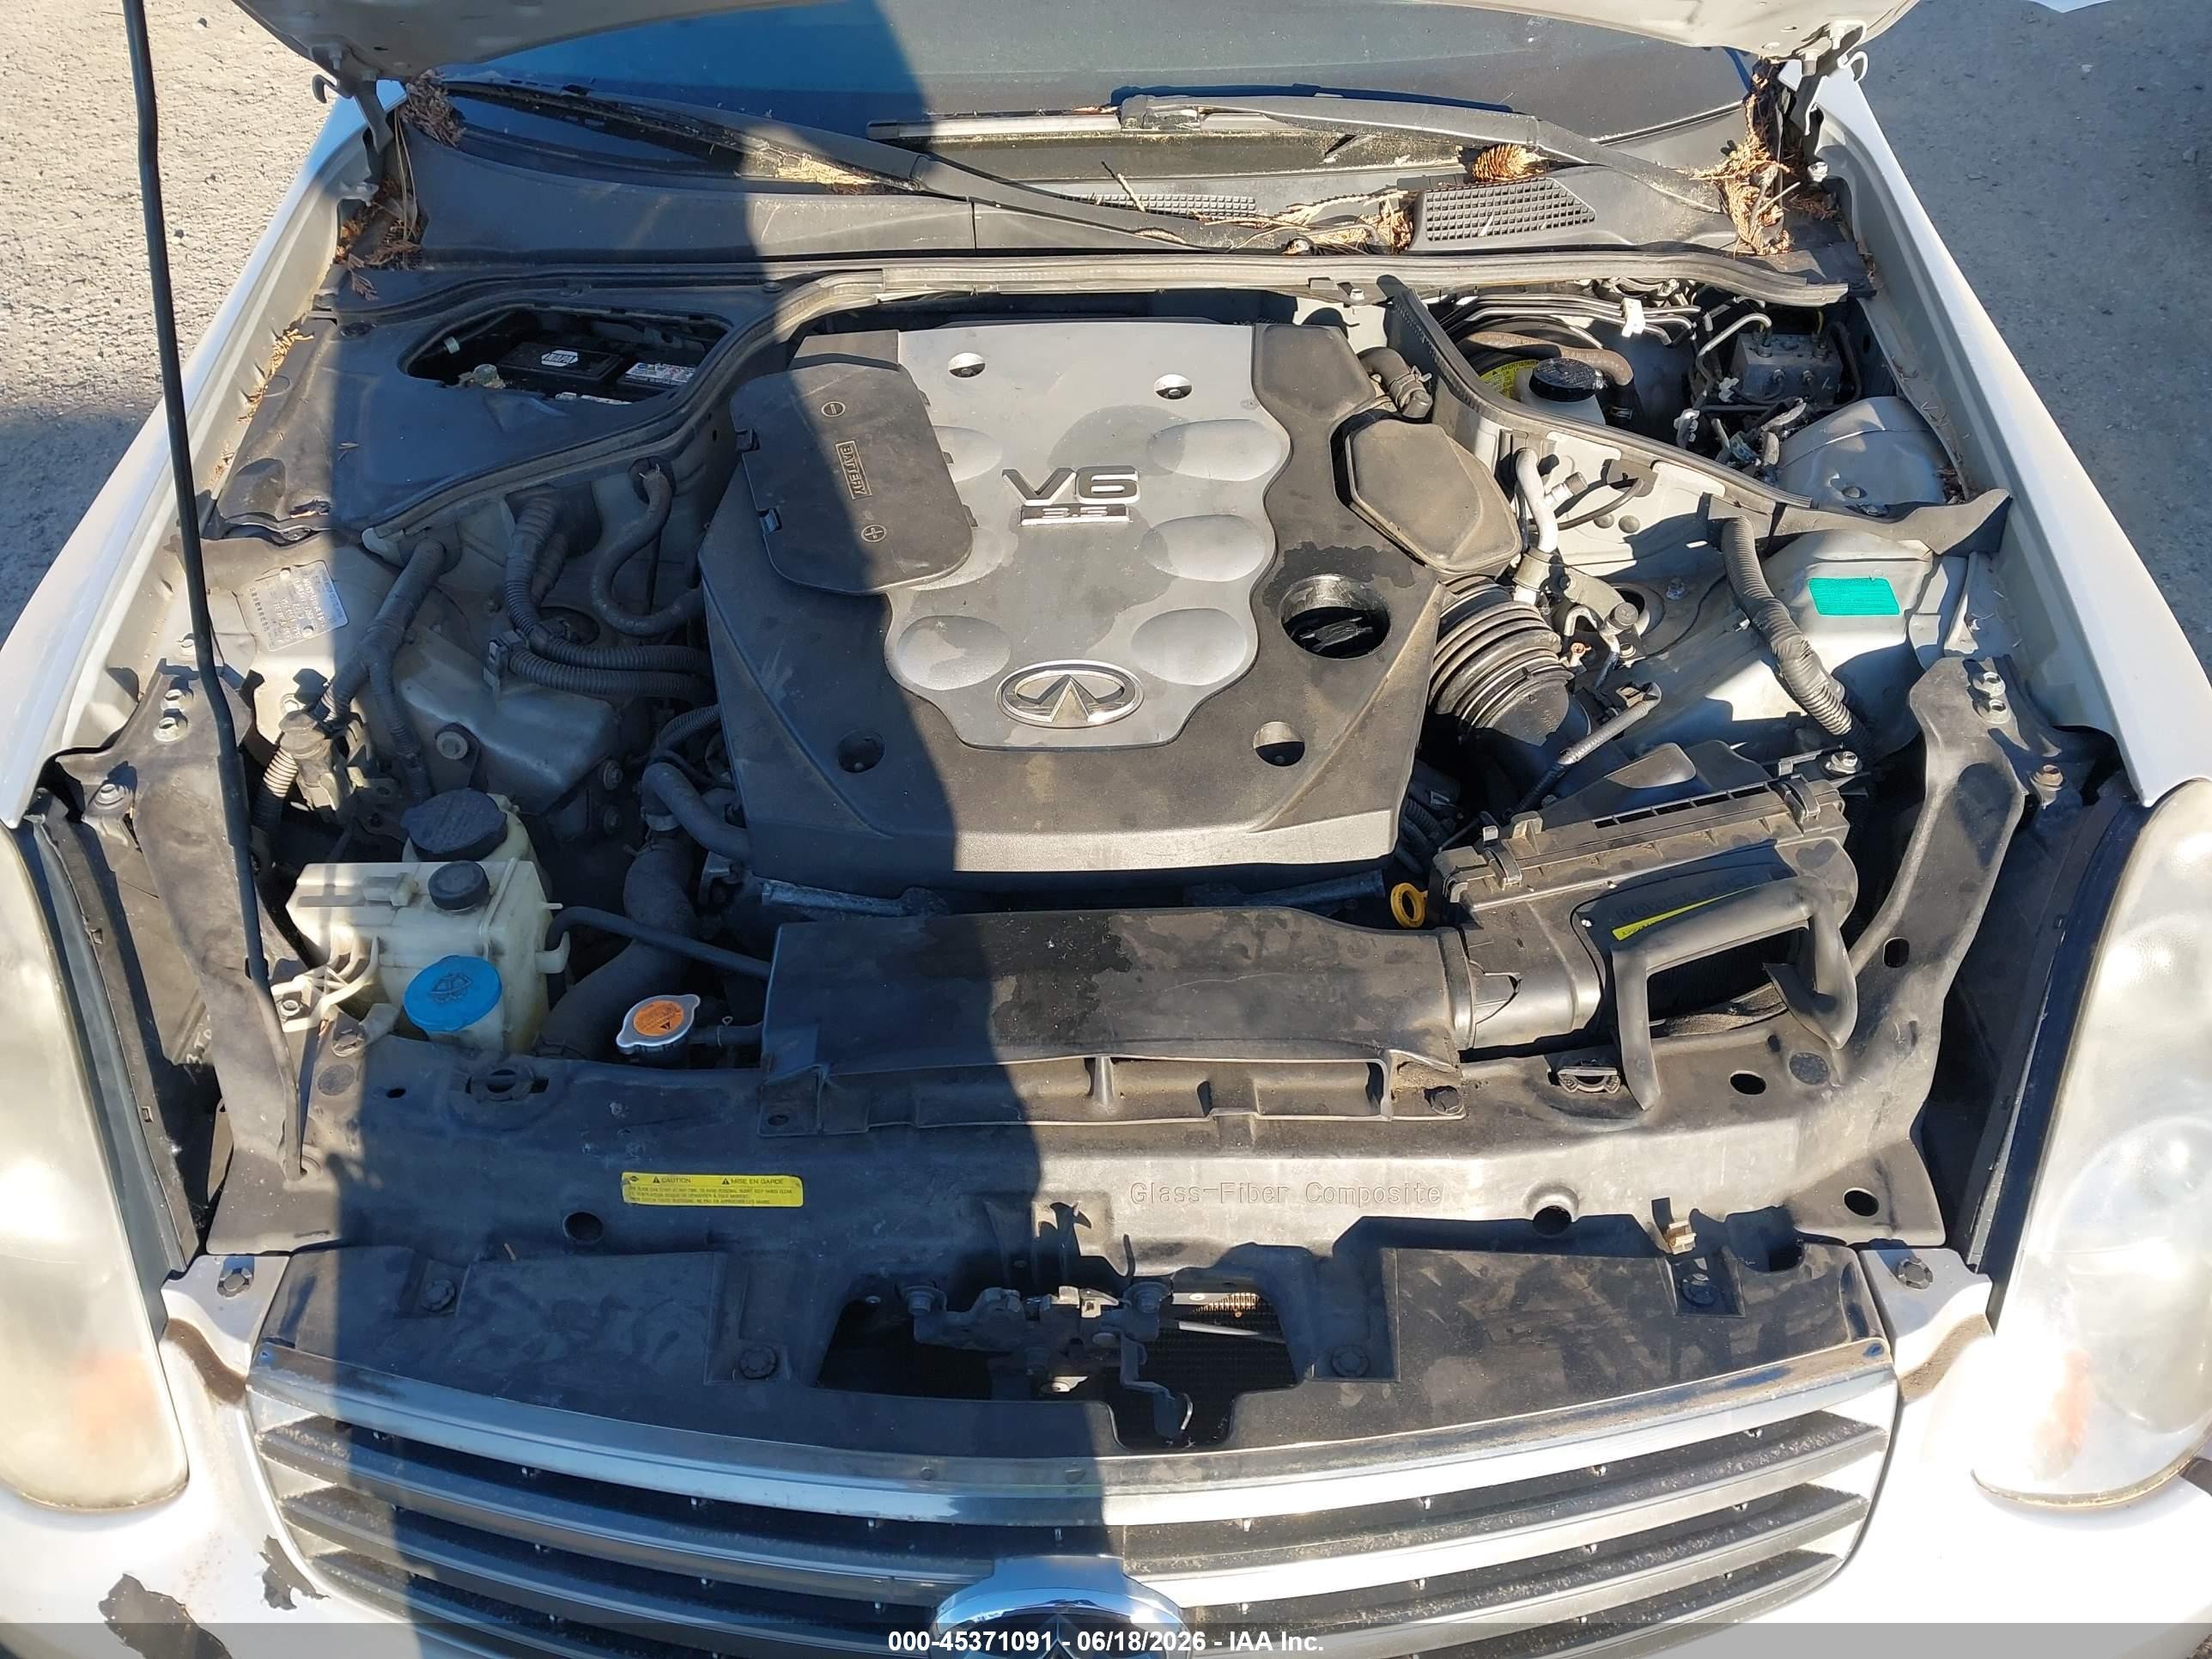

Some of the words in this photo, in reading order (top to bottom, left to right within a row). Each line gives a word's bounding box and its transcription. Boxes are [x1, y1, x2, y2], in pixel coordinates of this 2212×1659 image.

[840, 446, 867, 495] BATTERY
[1001, 465, 1141, 507] V6
[1042, 506, 1109, 519] 3.5
[1129, 1181, 1290, 1204] Glass-Fiber
[1305, 1181, 1443, 1209] Composite
